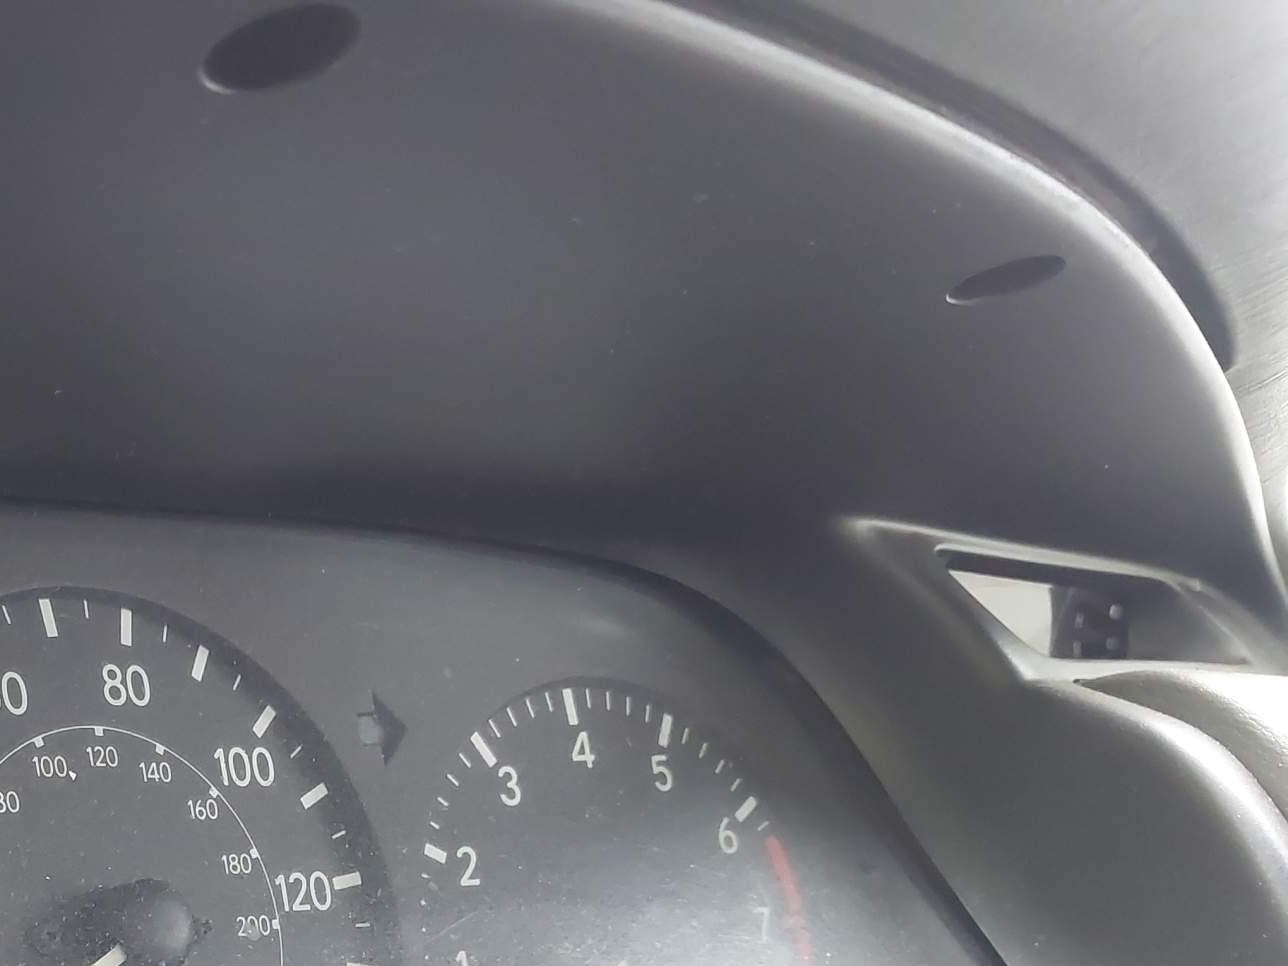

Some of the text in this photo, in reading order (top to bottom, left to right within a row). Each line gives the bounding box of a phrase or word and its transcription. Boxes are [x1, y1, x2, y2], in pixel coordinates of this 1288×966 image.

[101, 664, 150, 707] 80
[31, 755, 67, 778] 100
[86, 746, 119, 768] 120
[214, 747, 275, 787] 100
[572, 732, 595, 768] 4
[139, 761, 172, 783] 140
[498, 766, 521, 806] 3
[651, 754, 673, 791] 5
[187, 799, 220, 821] 160
[718, 817, 739, 854] 6
[221, 853, 252, 875] 180
[456, 847, 480, 887] 2
[275, 870, 332, 912] 120
[236, 915, 271, 938] 200
[753, 906, 772, 944] 7
